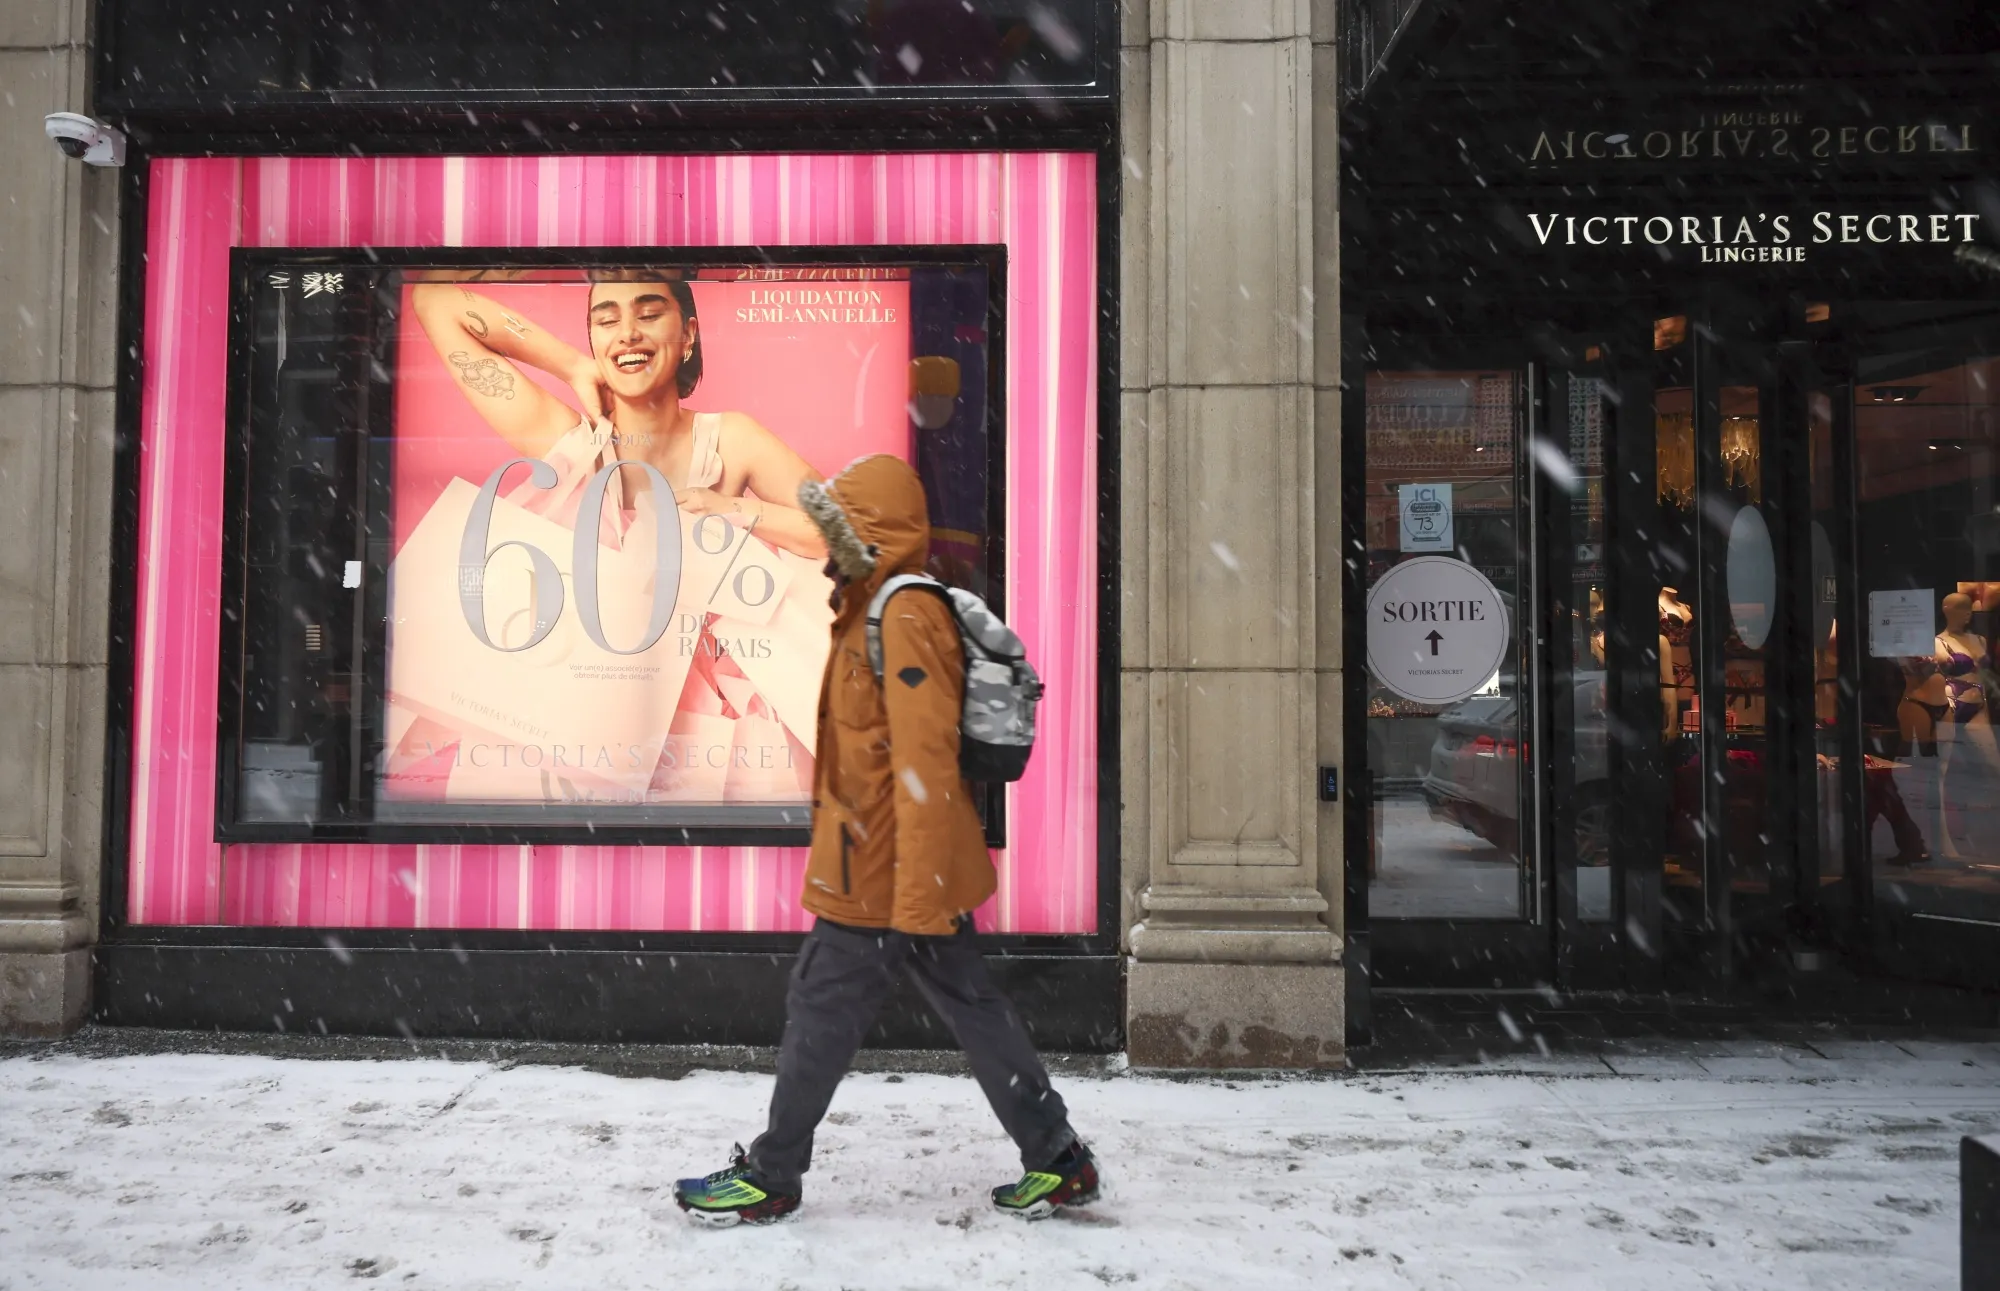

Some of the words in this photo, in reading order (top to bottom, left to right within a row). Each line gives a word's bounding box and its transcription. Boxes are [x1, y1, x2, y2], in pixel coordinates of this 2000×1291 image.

[1527, 213, 1791, 246] VICTORIA'S
[1812, 212, 1980, 243] SECRET
[1701, 246, 1806, 263] LINGERIE
[751, 290, 881, 307] LIQUIDATION
[736, 308, 896, 323] SEMI-ANNUELLE
[1415, 489, 1435, 501] ICI
[1414, 517, 1434, 531] 73
[1383, 600, 1485, 623] SORTIE
[678, 614, 713, 635] DE
[678, 636, 772, 659] RABAIS
[585, 664, 604, 673] un(e)
[425, 741, 642, 769] VICTORIA'S
[661, 740, 794, 769] SECRET
